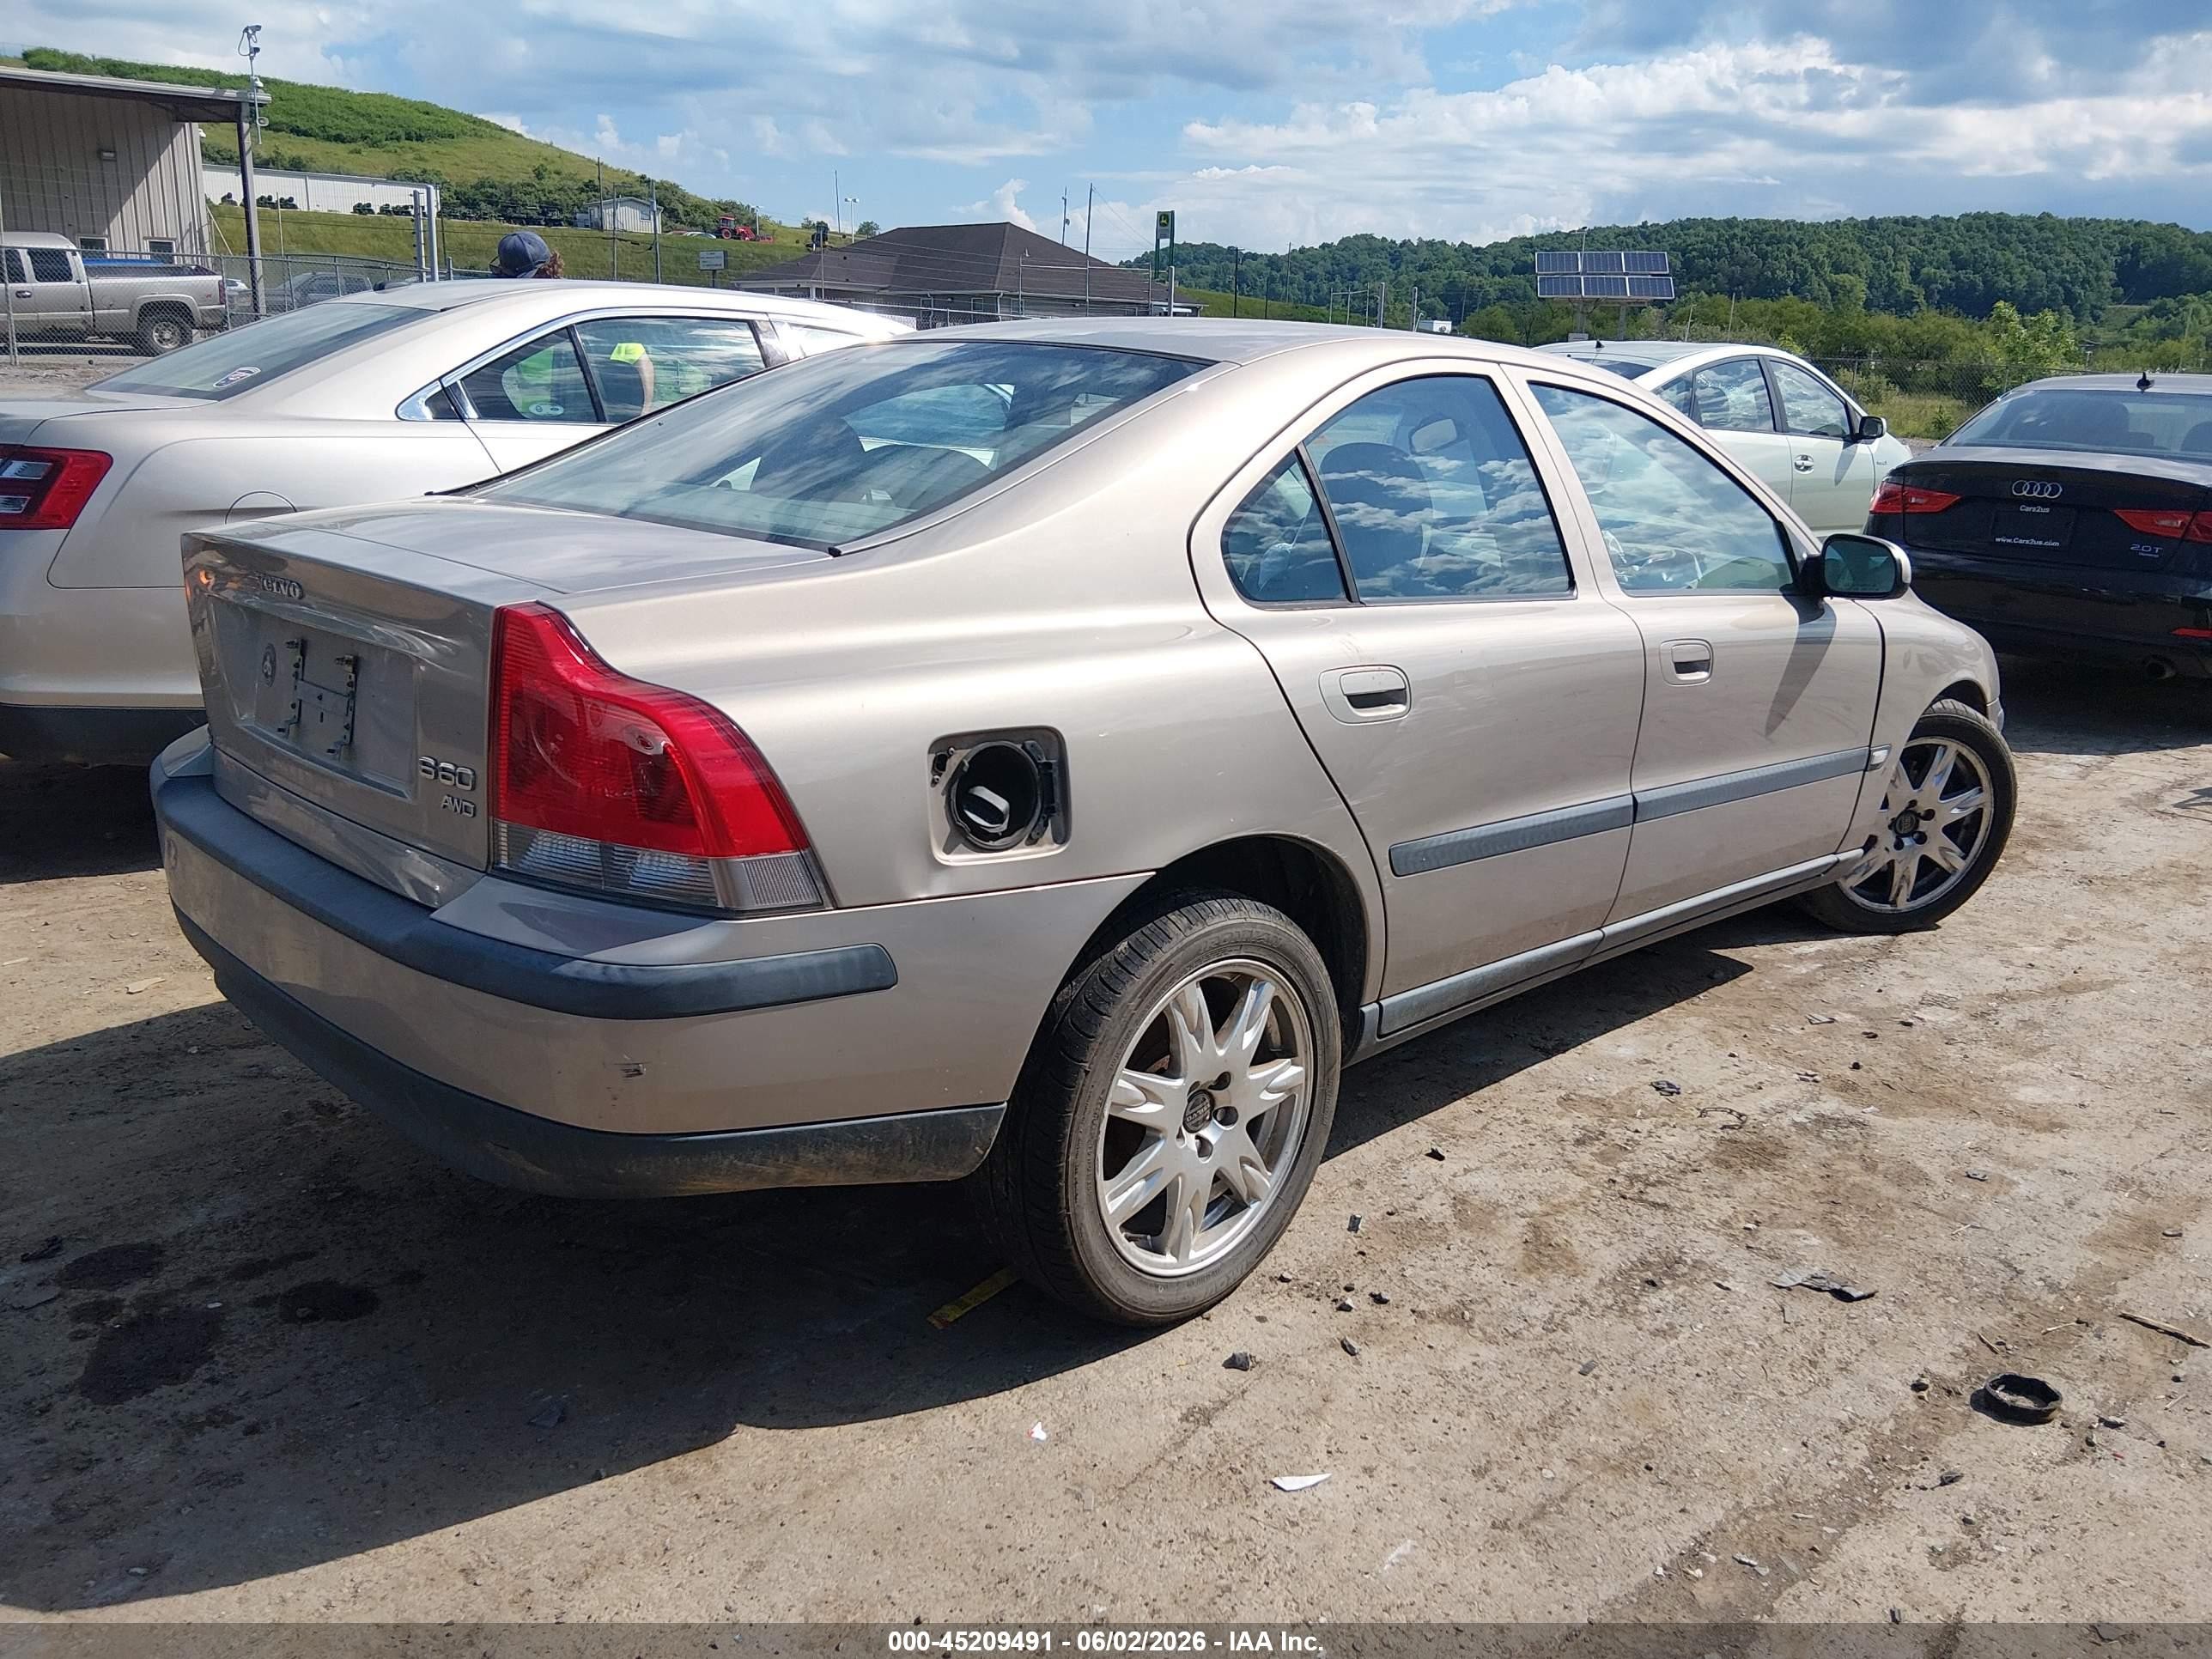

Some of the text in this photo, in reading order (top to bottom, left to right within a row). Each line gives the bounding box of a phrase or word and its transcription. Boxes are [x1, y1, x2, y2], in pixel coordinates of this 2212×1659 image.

[2019, 504, 2050, 513] Cars2us
[1995, 537, 2059, 546] www.Cars2us.com
[418, 756, 477, 791] S60
[441, 794, 476, 817] AWD
